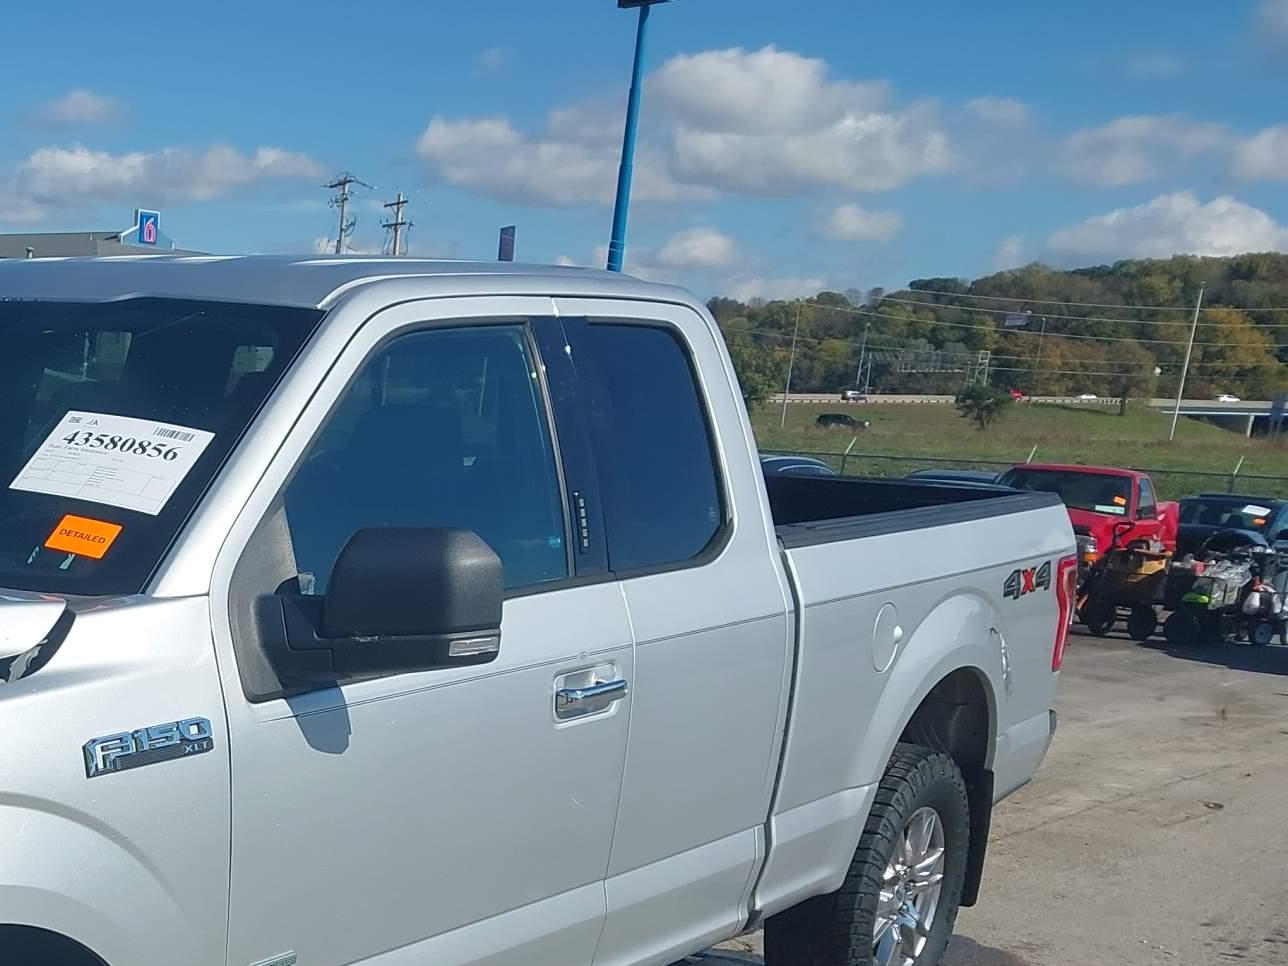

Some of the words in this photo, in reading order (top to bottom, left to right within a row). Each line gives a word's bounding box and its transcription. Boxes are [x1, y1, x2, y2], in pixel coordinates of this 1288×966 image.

[144, 217, 156, 242] 6
[62, 430, 184, 461] 43580856
[59, 528, 106, 544] DETAILED
[183, 740, 209, 754] XLT
